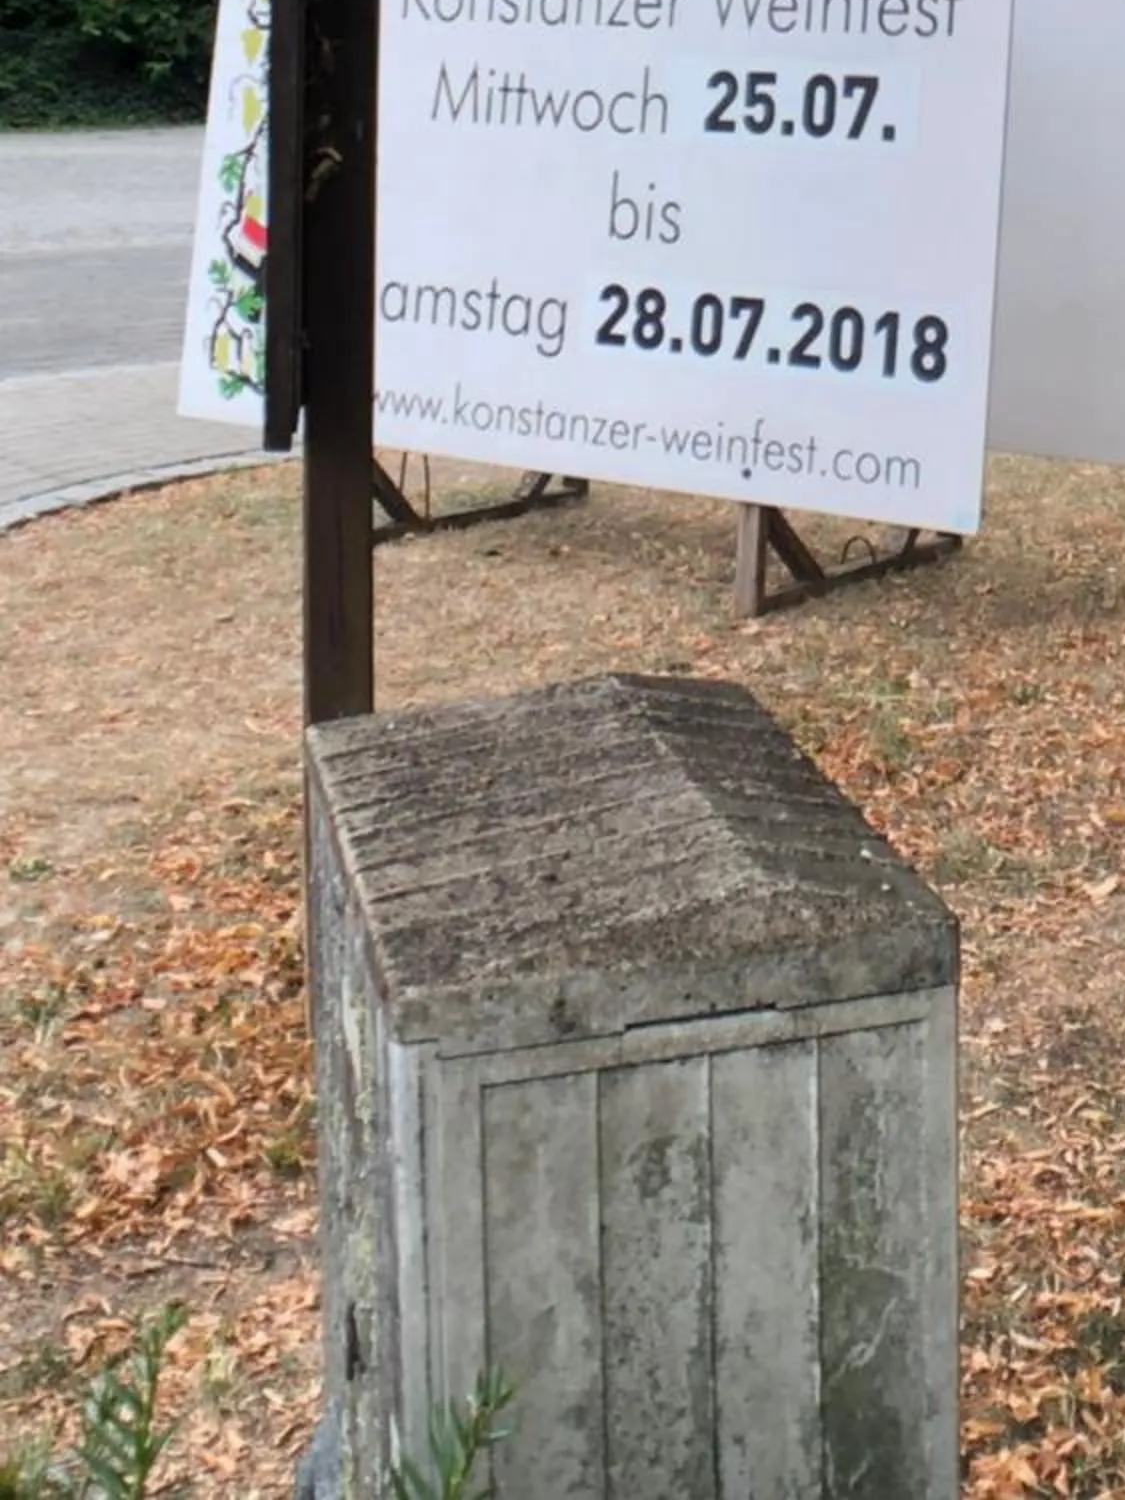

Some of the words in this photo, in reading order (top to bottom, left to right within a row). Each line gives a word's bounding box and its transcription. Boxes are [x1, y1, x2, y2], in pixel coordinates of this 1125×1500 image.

[431, 63, 668, 135] Mittwoch
[703, 69, 897, 143] 25.07.
[608, 170, 682, 245] bis
[381, 277, 568, 359] amstag
[594, 282, 950, 384] 28.07.2018
